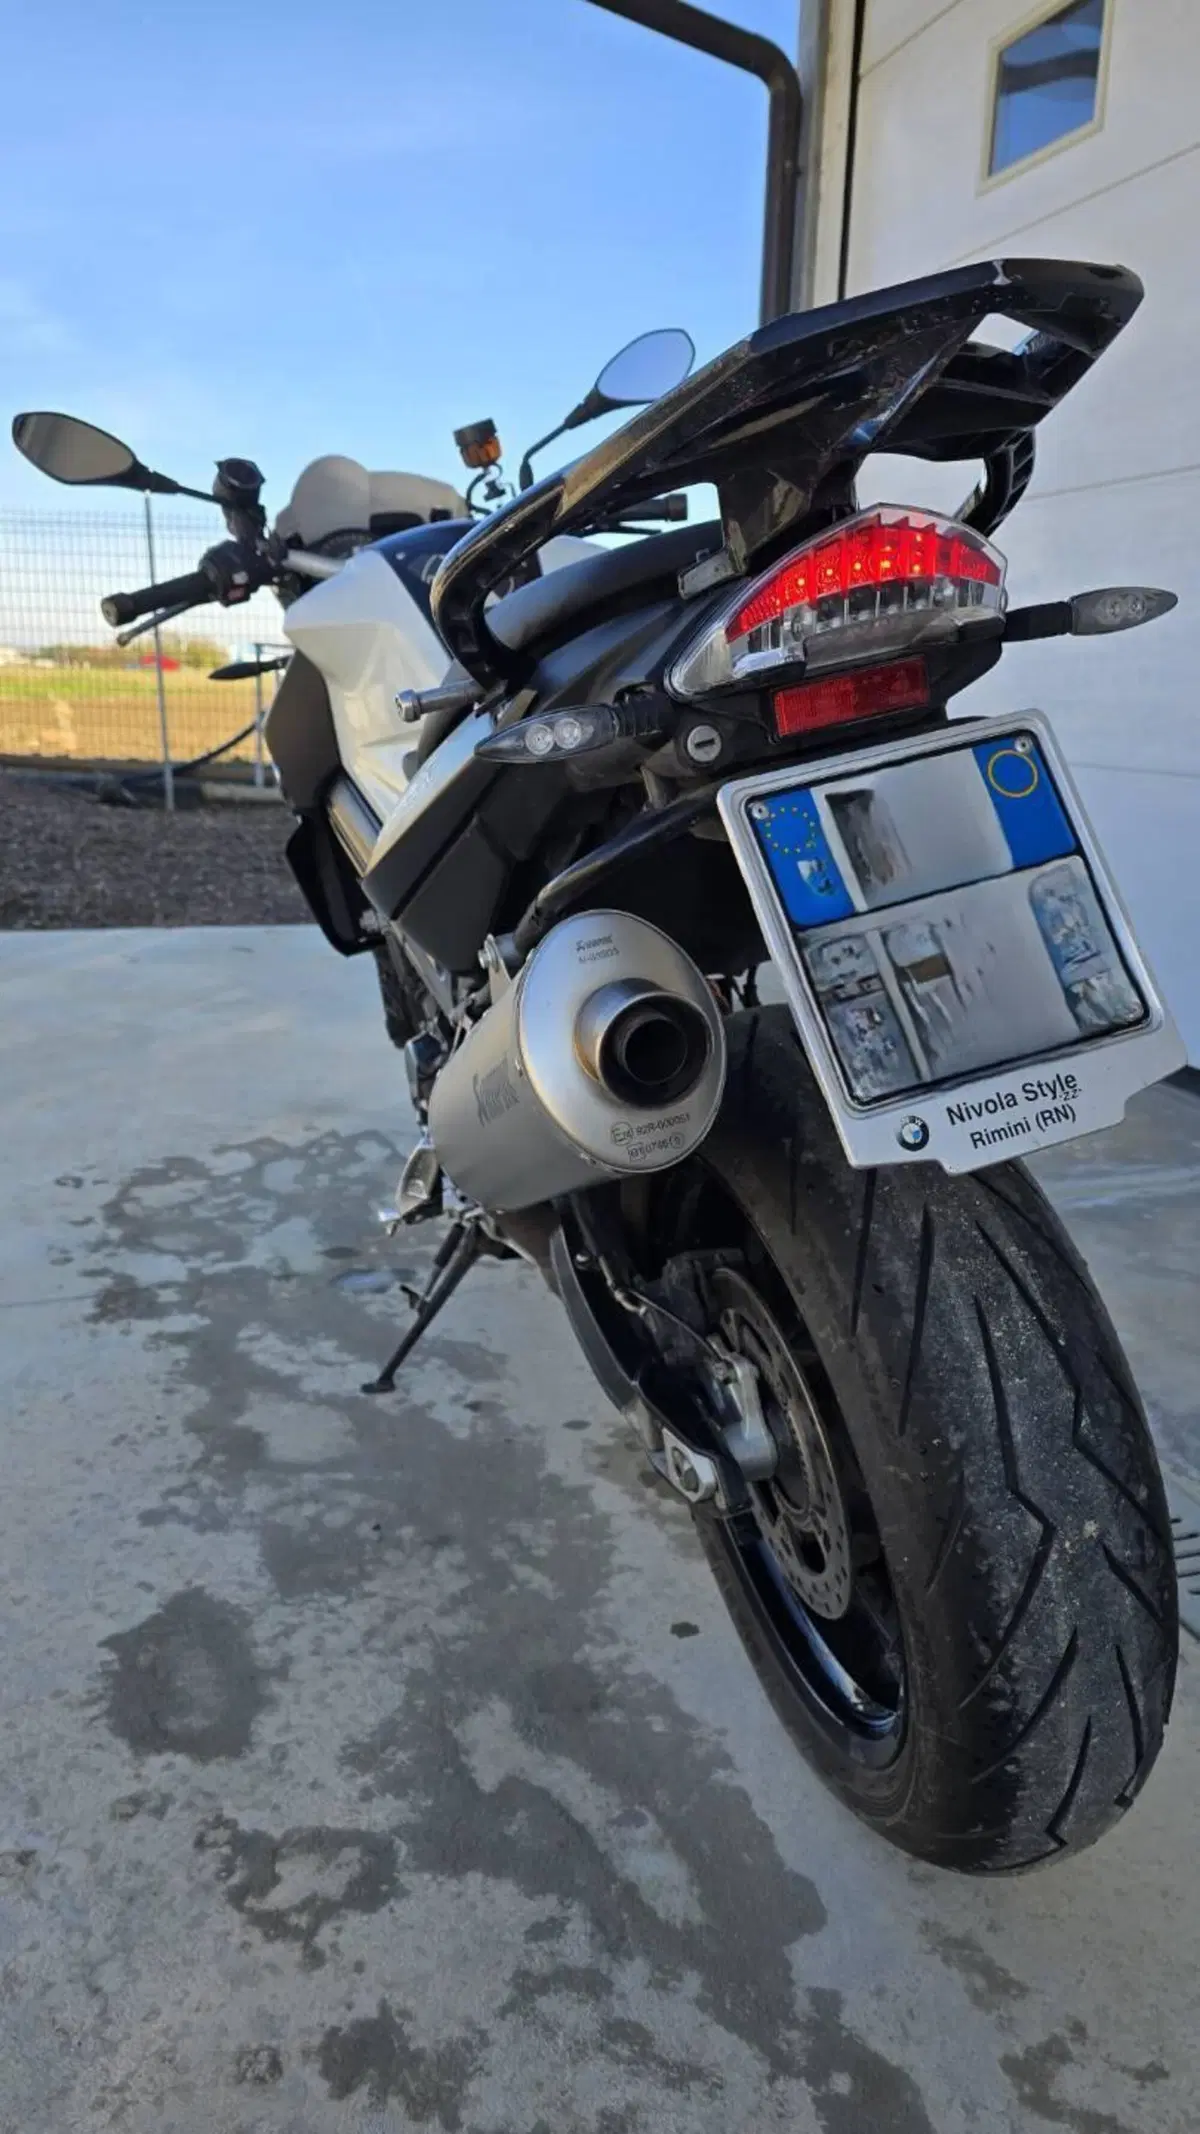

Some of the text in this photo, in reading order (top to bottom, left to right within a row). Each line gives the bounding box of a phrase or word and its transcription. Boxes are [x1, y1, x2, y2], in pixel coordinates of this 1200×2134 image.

[946, 1073, 1078, 1126] Nivola Style
[970, 1103, 1077, 1149] Rimini (RN)
